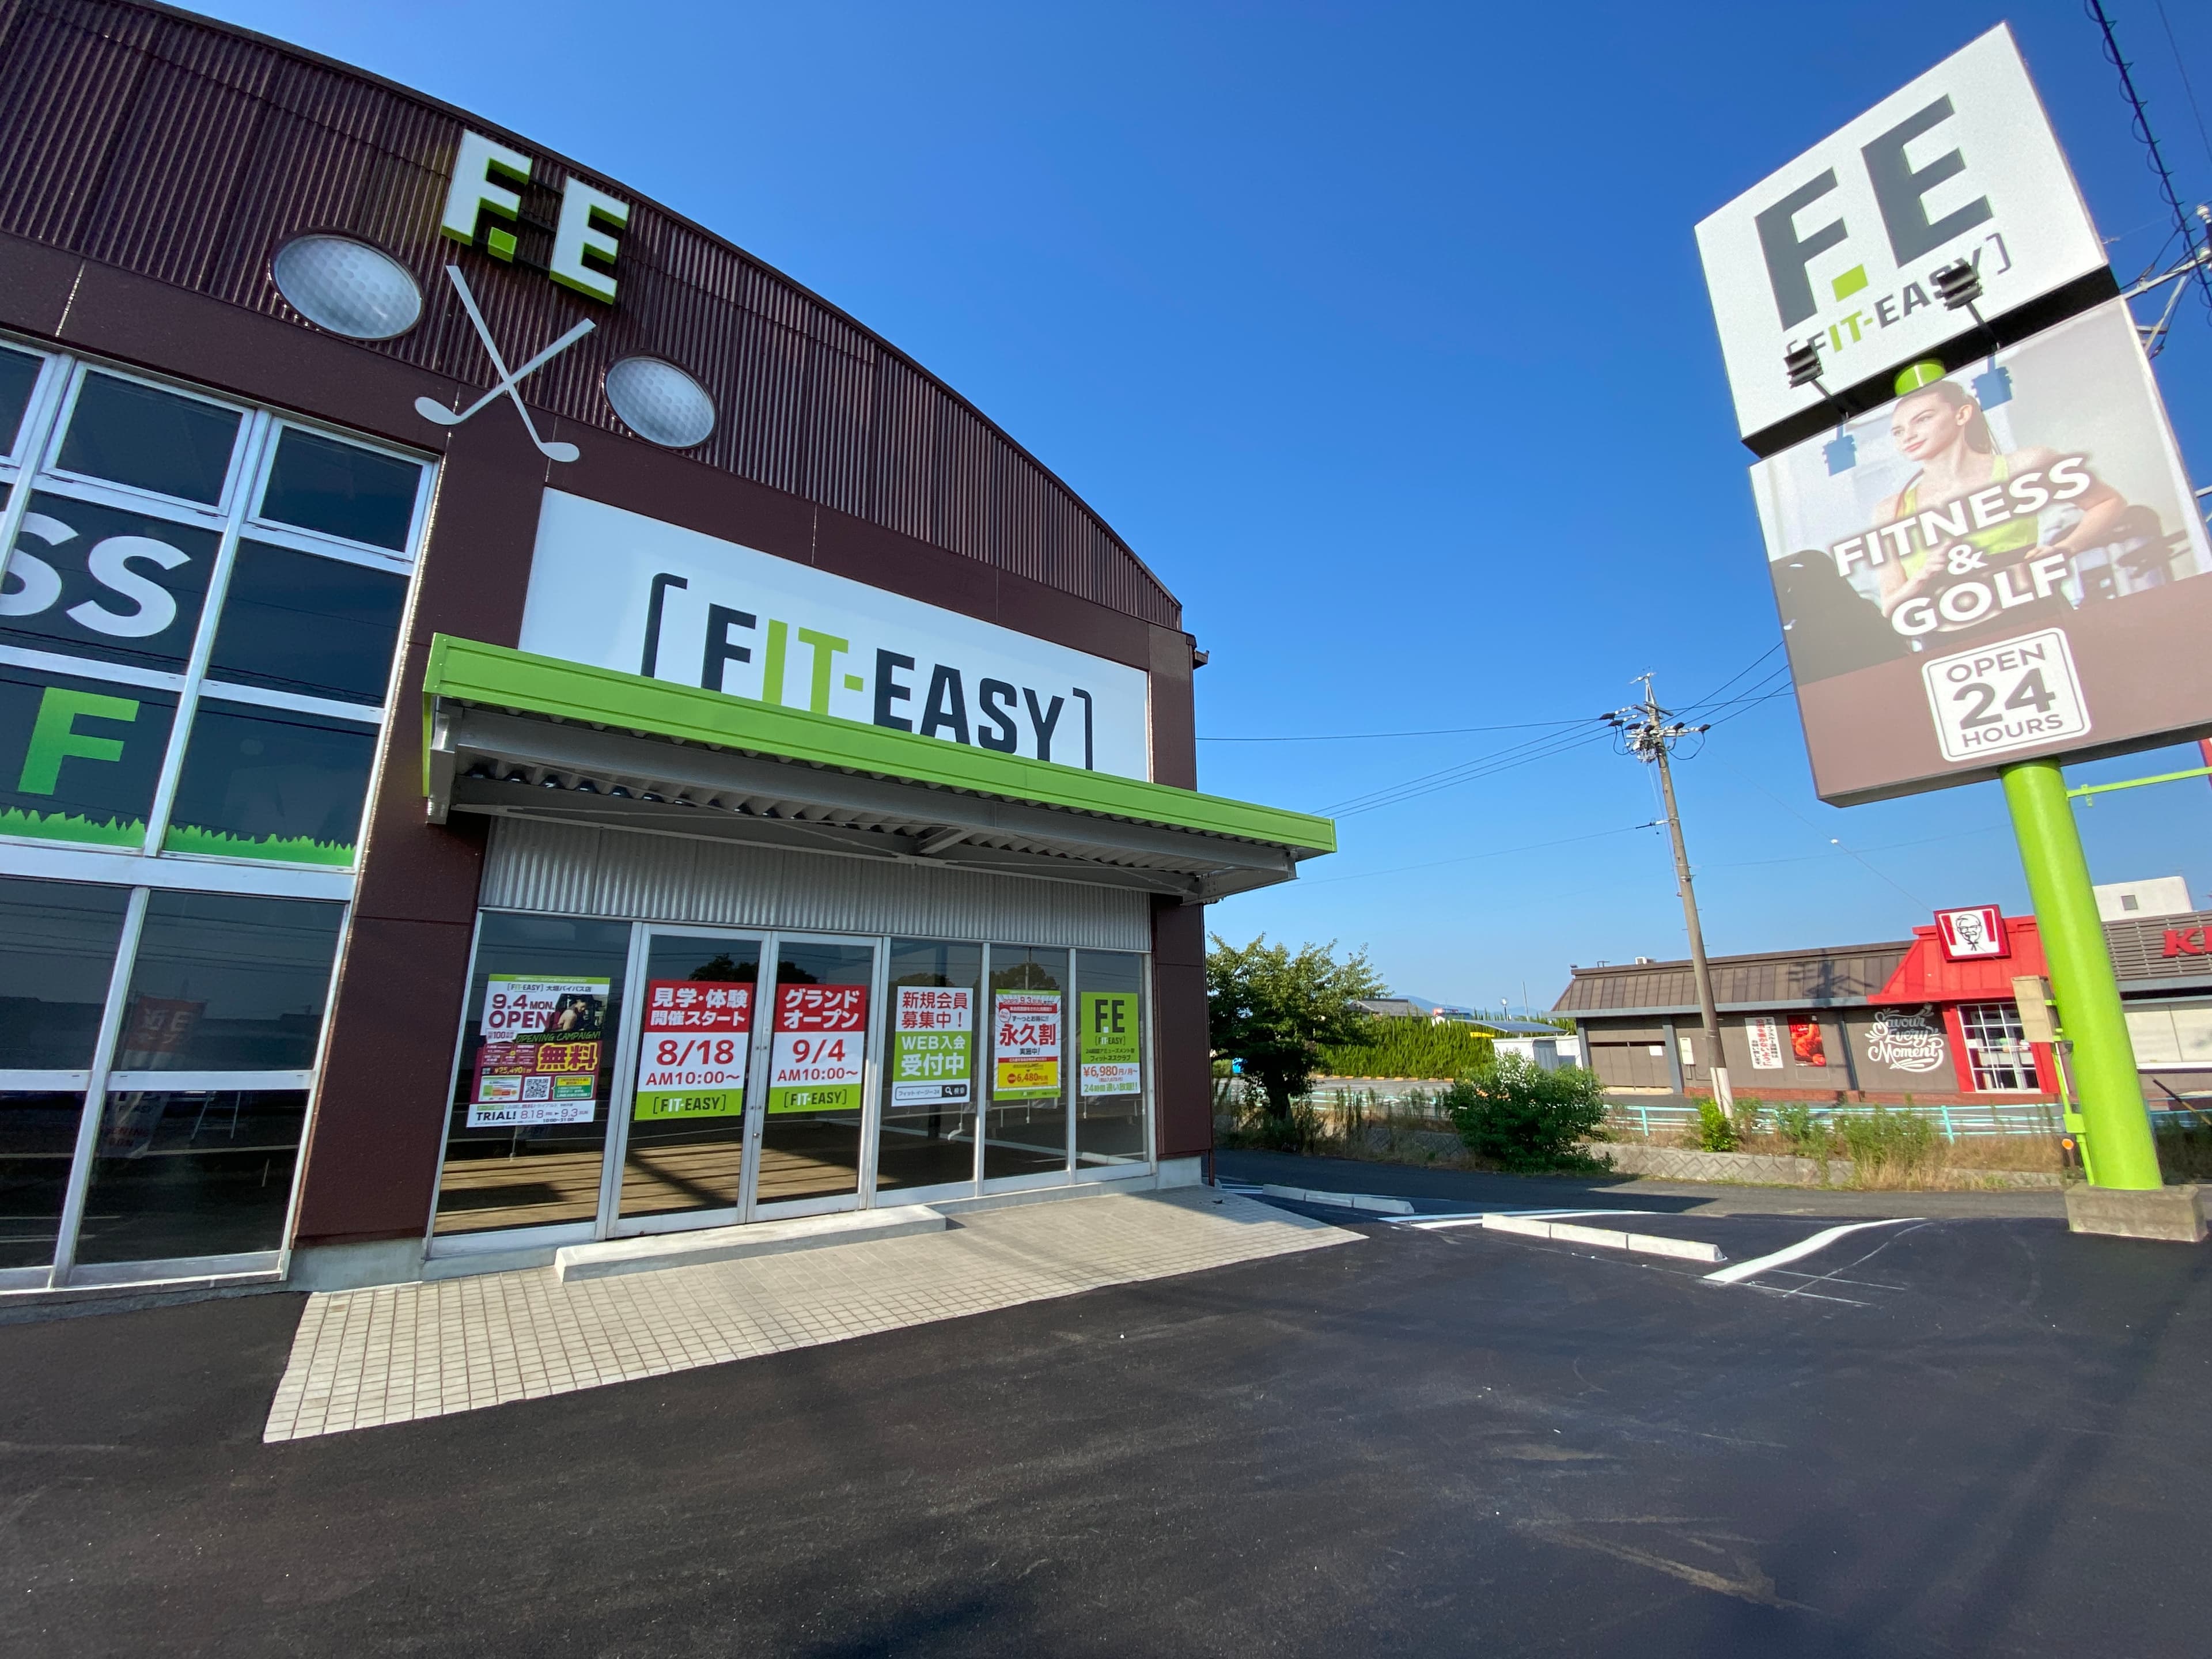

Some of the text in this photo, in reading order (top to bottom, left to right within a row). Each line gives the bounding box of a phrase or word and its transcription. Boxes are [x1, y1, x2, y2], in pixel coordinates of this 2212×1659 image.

[1832, 457, 2091, 577] FITNESS
[1948, 544, 1988, 576] &
[1891, 553, 2068, 637] GOLF
[1946, 642, 2047, 683] OPEN
[1952, 666, 2056, 730] 24
[1961, 713, 2064, 749] HOURS
[492, 994, 555, 1010] 9.4 MON.
[653, 987, 748, 1009] 見学・体験
[785, 988, 860, 1009] グランド
[902, 991, 968, 1010] 新規会員
[650, 1010, 745, 1027] 開催スタート
[783, 1009, 859, 1029] オープン
[901, 1011, 962, 1029] 募集中!
[1872, 1010, 1927, 1036] Savour
[516, 1033, 554, 1043] OPENING
[901, 1035, 966, 1050] WEB入会
[999, 1023, 1056, 1047] 永久割
[1884, 1028, 1934, 1048] Every
[537, 1042, 598, 1071] 無料
[656, 1039, 734, 1067] 8/18
[792, 1039, 846, 1064] 9/4
[1867, 1037, 1944, 1072] Moment
[901, 1052, 965, 1077] 受付中
[476, 1111, 517, 1121] TRIAL!
[521, 1109, 544, 1119] 8.18
[560, 1108, 578, 1118] 9.3
